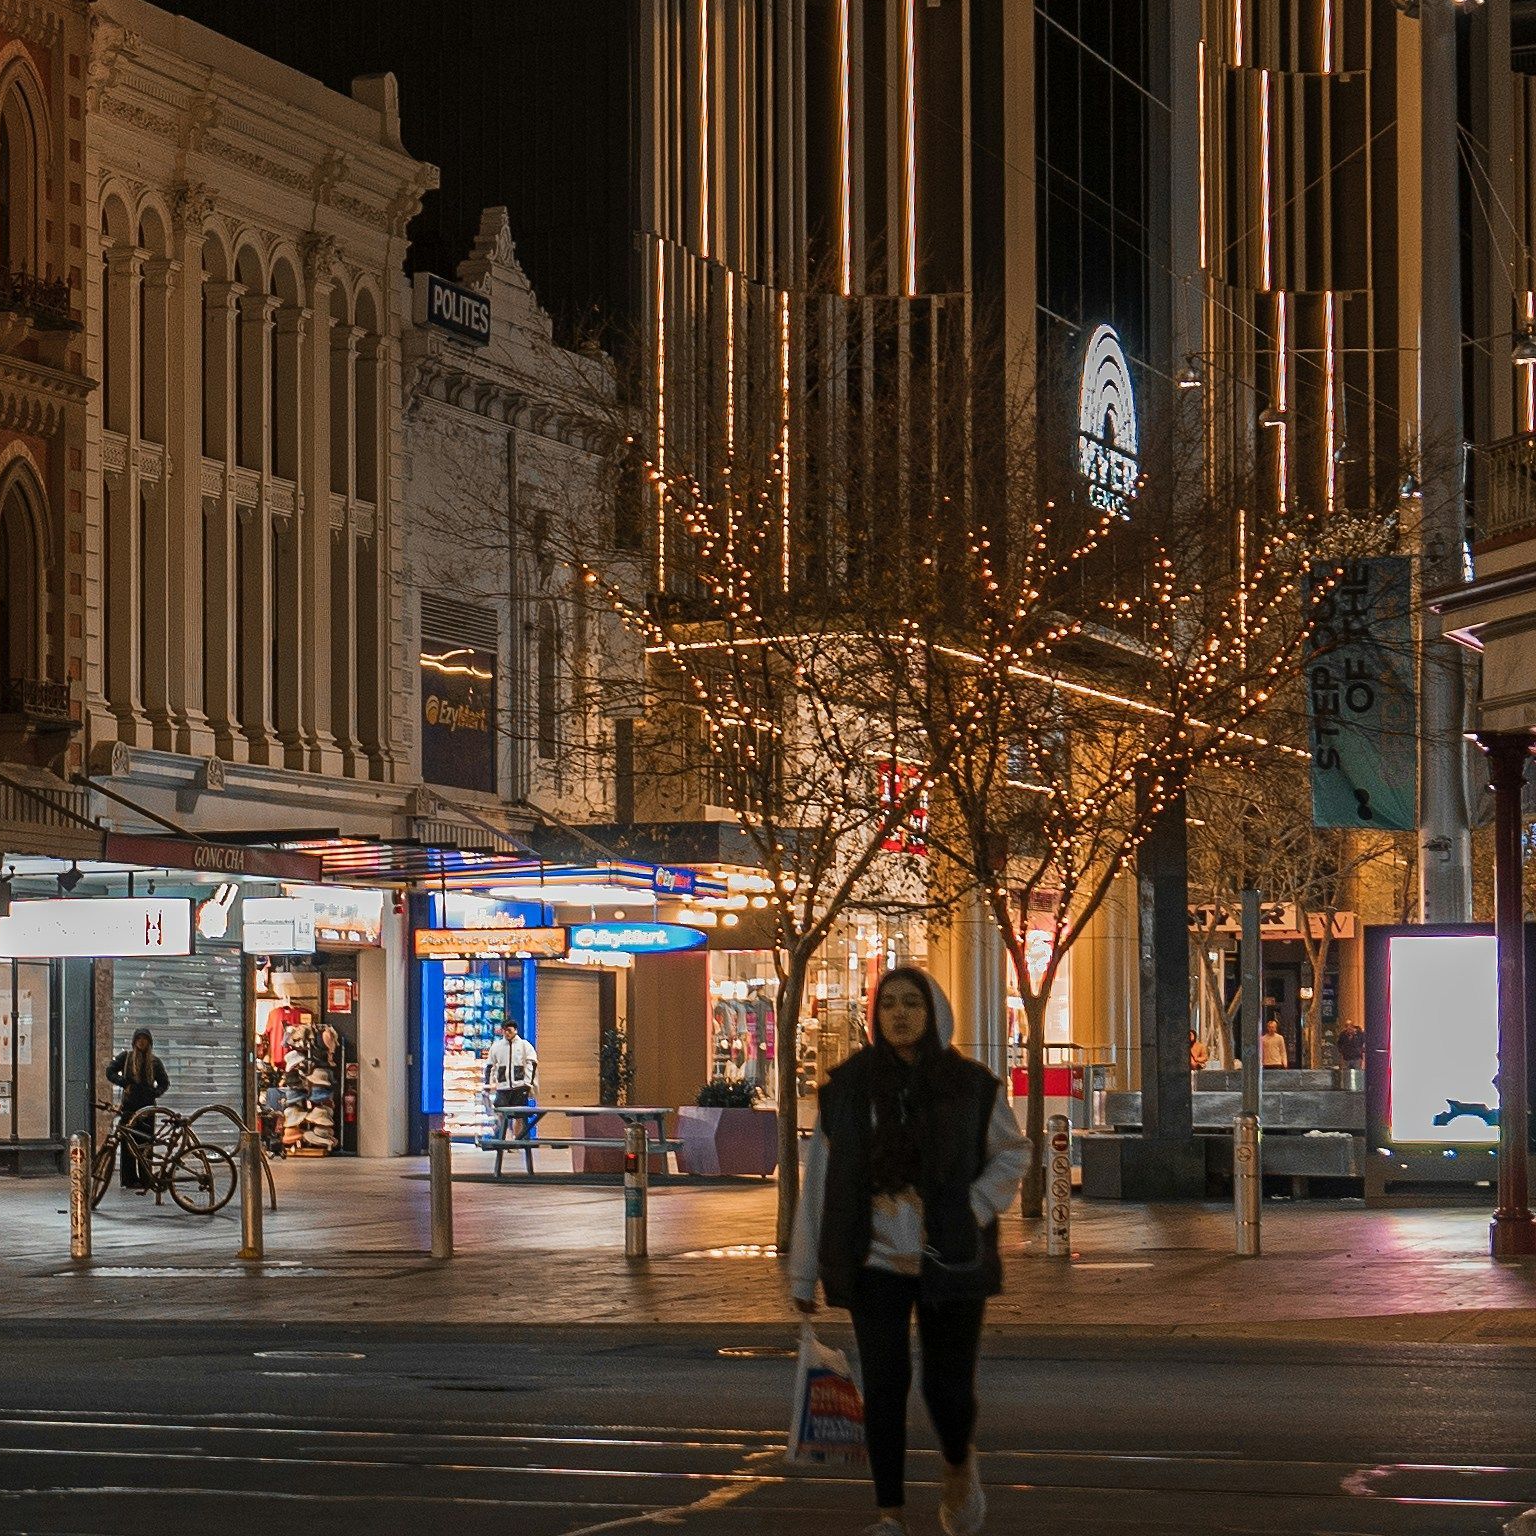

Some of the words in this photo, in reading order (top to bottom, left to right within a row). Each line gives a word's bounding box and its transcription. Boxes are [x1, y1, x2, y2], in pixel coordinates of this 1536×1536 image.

[434, 284, 489, 334] POLITES
[1344, 658, 1375, 714] OF
[1310, 667, 1341, 770] STEP
[194, 846, 223, 868] GONG
[224, 849, 245, 871] CHA
